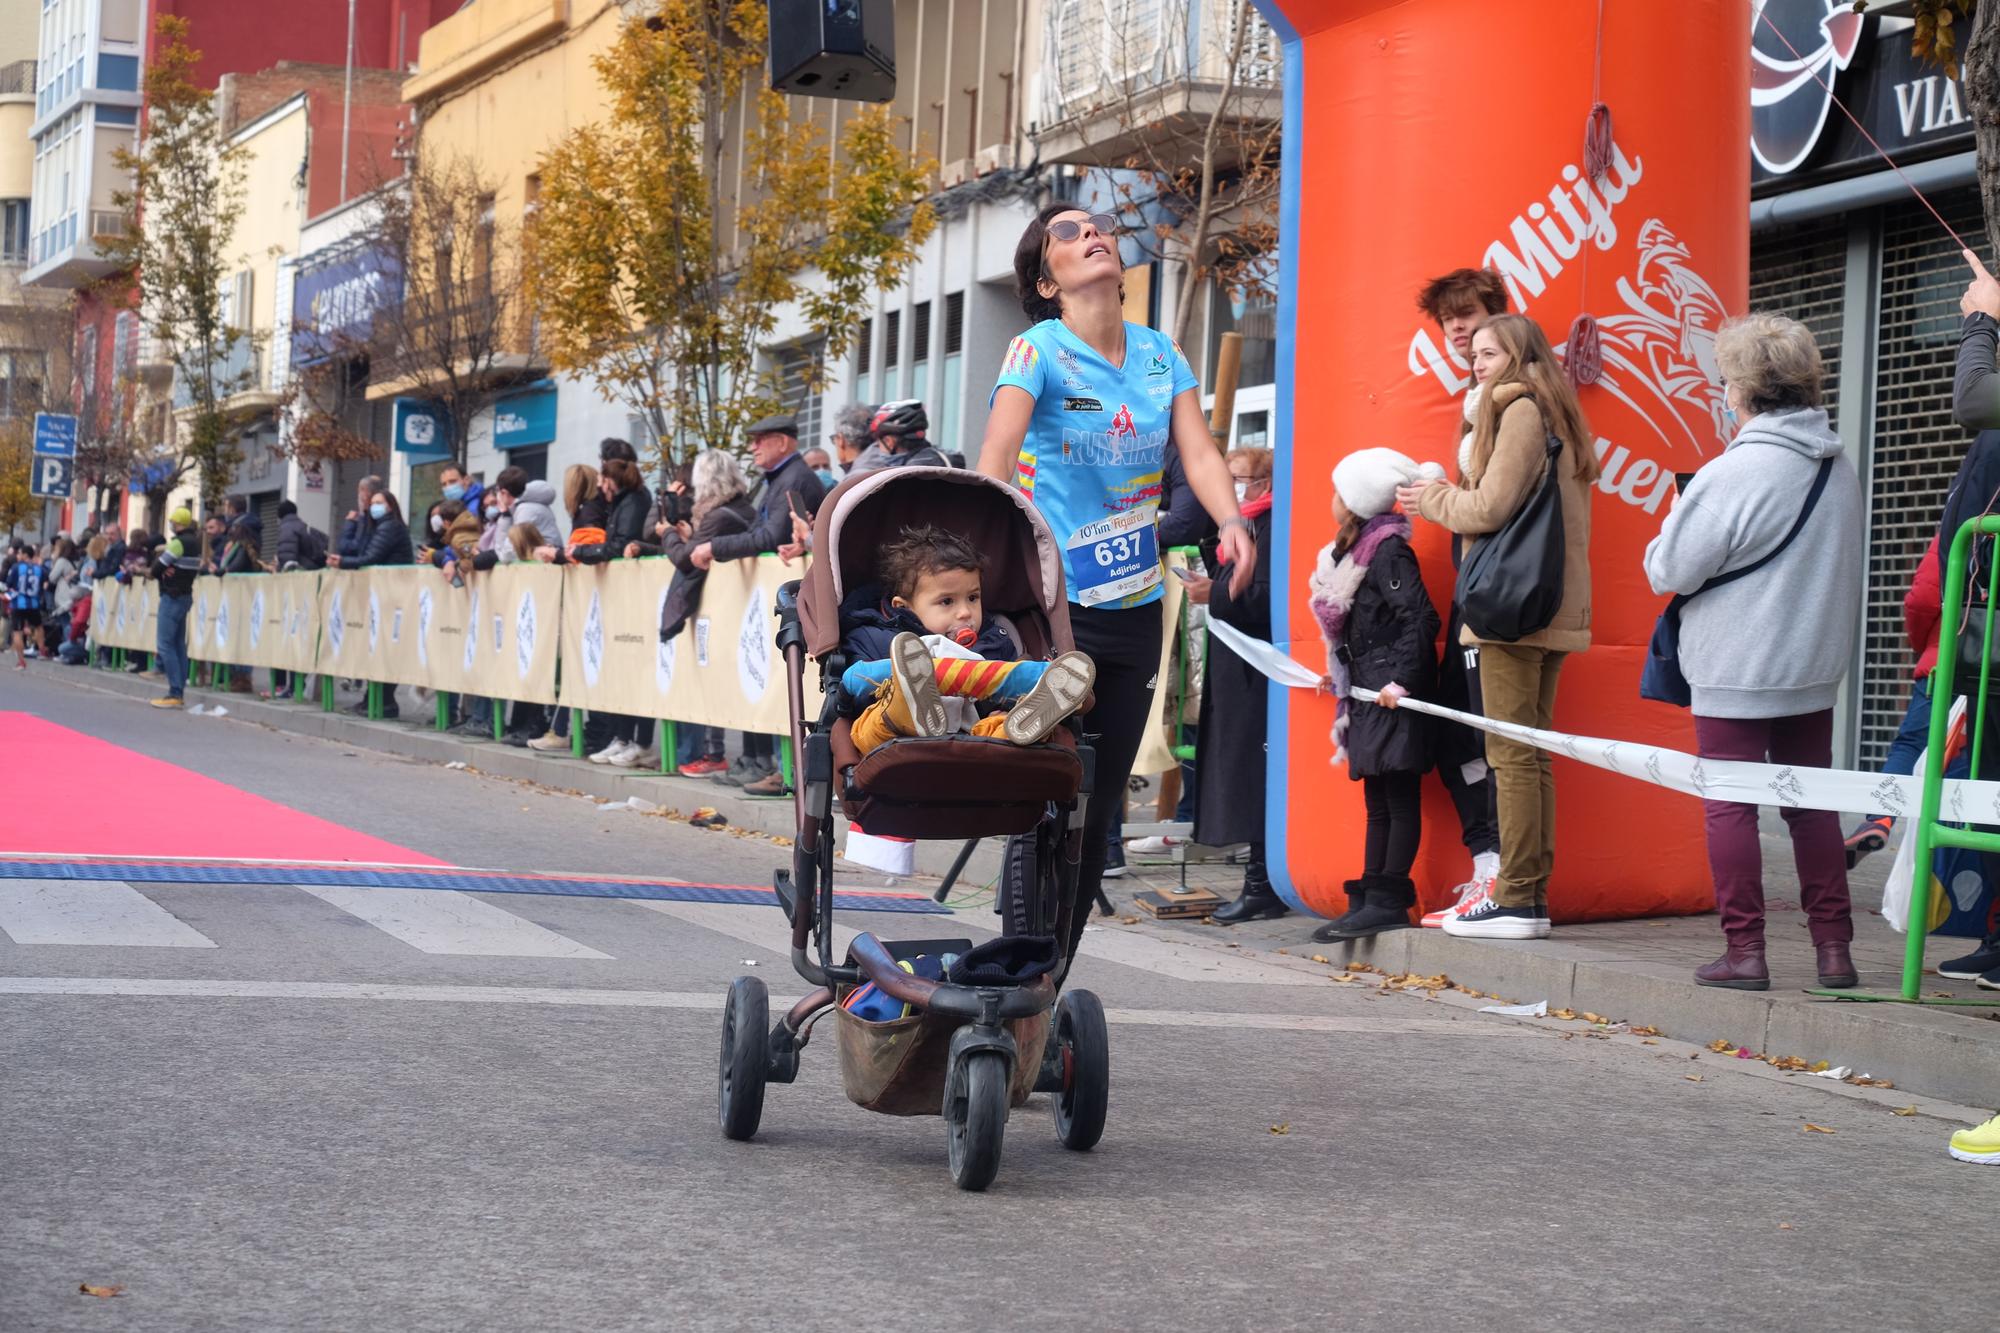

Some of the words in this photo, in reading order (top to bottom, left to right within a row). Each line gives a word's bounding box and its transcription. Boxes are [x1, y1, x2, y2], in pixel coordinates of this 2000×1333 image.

[1893, 64, 1972, 137] VIA
[1482, 141, 1642, 314] Mitja
[1062, 427, 1169, 466] RUNNING
[41, 459, 63, 493] P
[1094, 531, 1141, 567] 637
[18, 575, 40, 597] 13
[1110, 562, 1141, 578] Adjiriou
